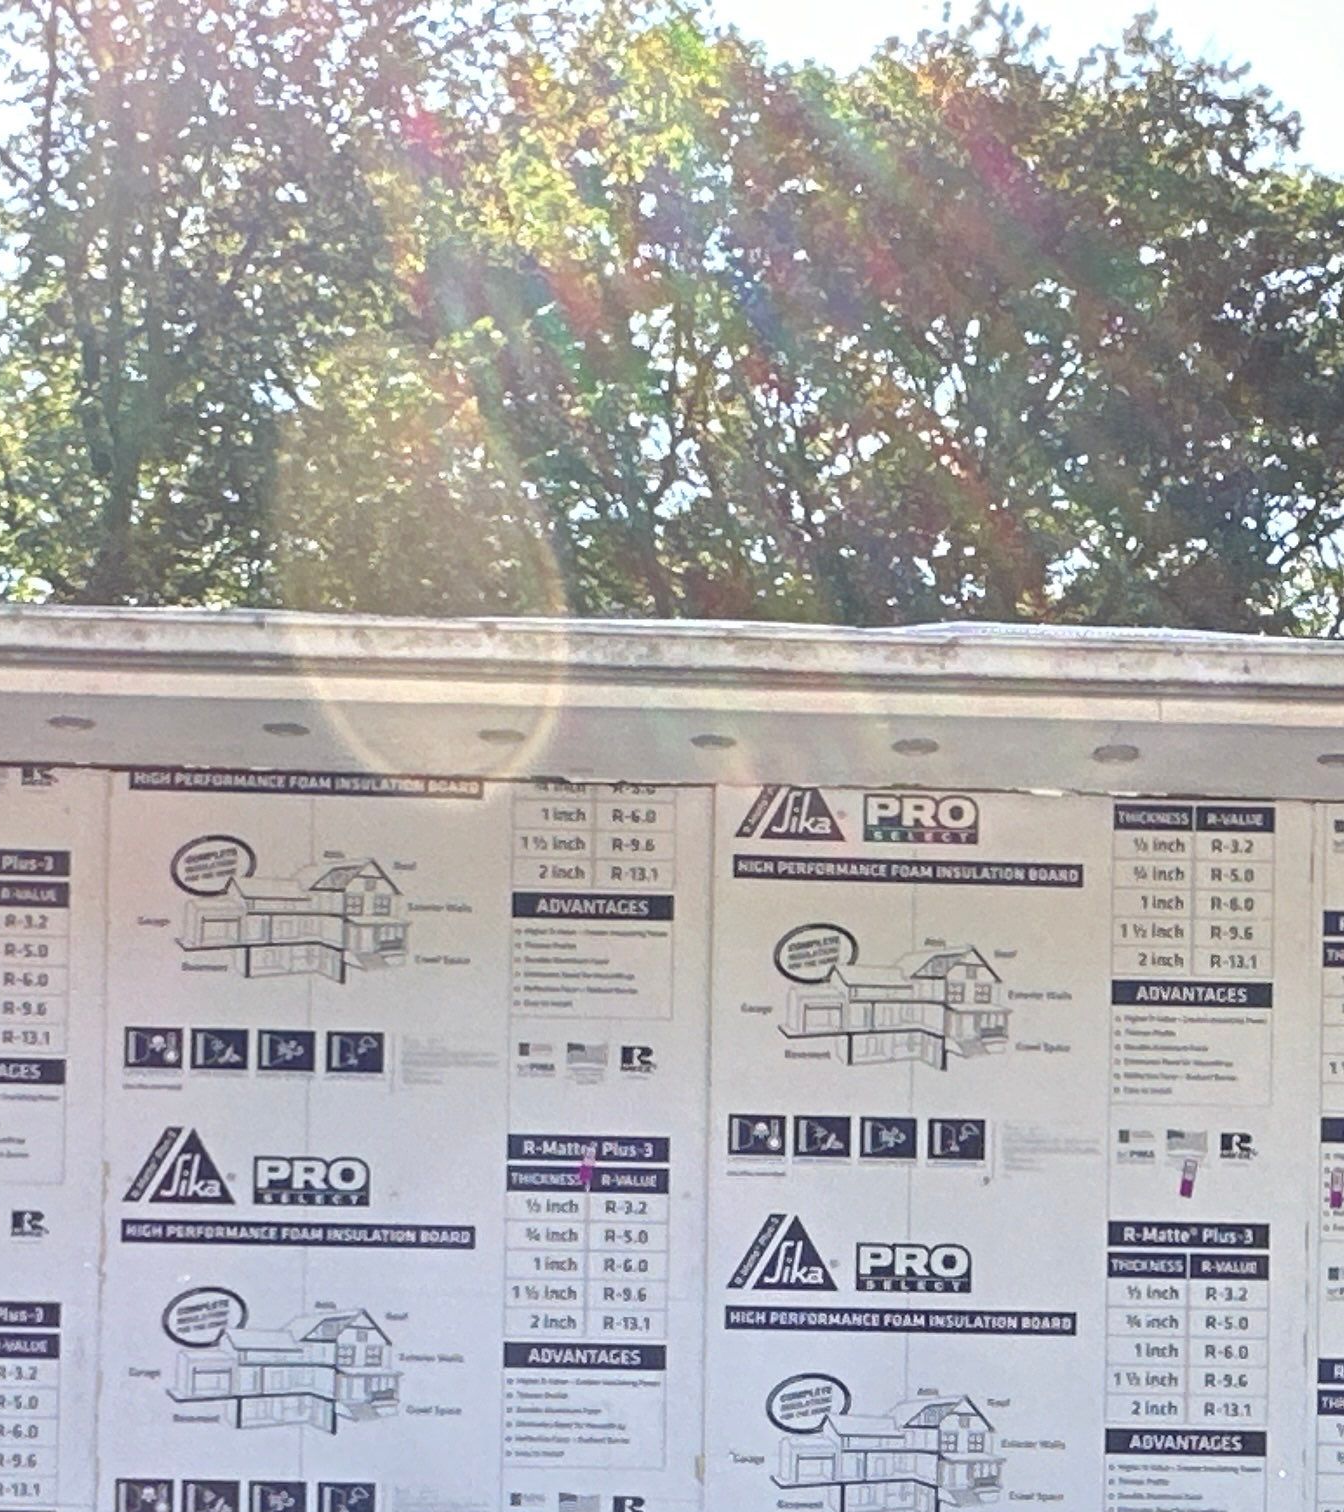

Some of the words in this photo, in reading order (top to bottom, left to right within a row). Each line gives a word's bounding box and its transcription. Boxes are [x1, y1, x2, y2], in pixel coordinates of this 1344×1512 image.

[772, 790, 831, 834] Sika
[867, 797, 976, 830] PRO
[536, 898, 650, 915] ADVANTAGES
[1136, 986, 1248, 1003] ADVANTAGES
[161, 1153, 221, 1197] Sika
[256, 1159, 367, 1191] PRO
[764, 1240, 824, 1284] Sika
[859, 1246, 969, 1278] PRO
[528, 1348, 642, 1365] ADVANTAGES
[1130, 1434, 1242, 1451] ADVANTAGES
